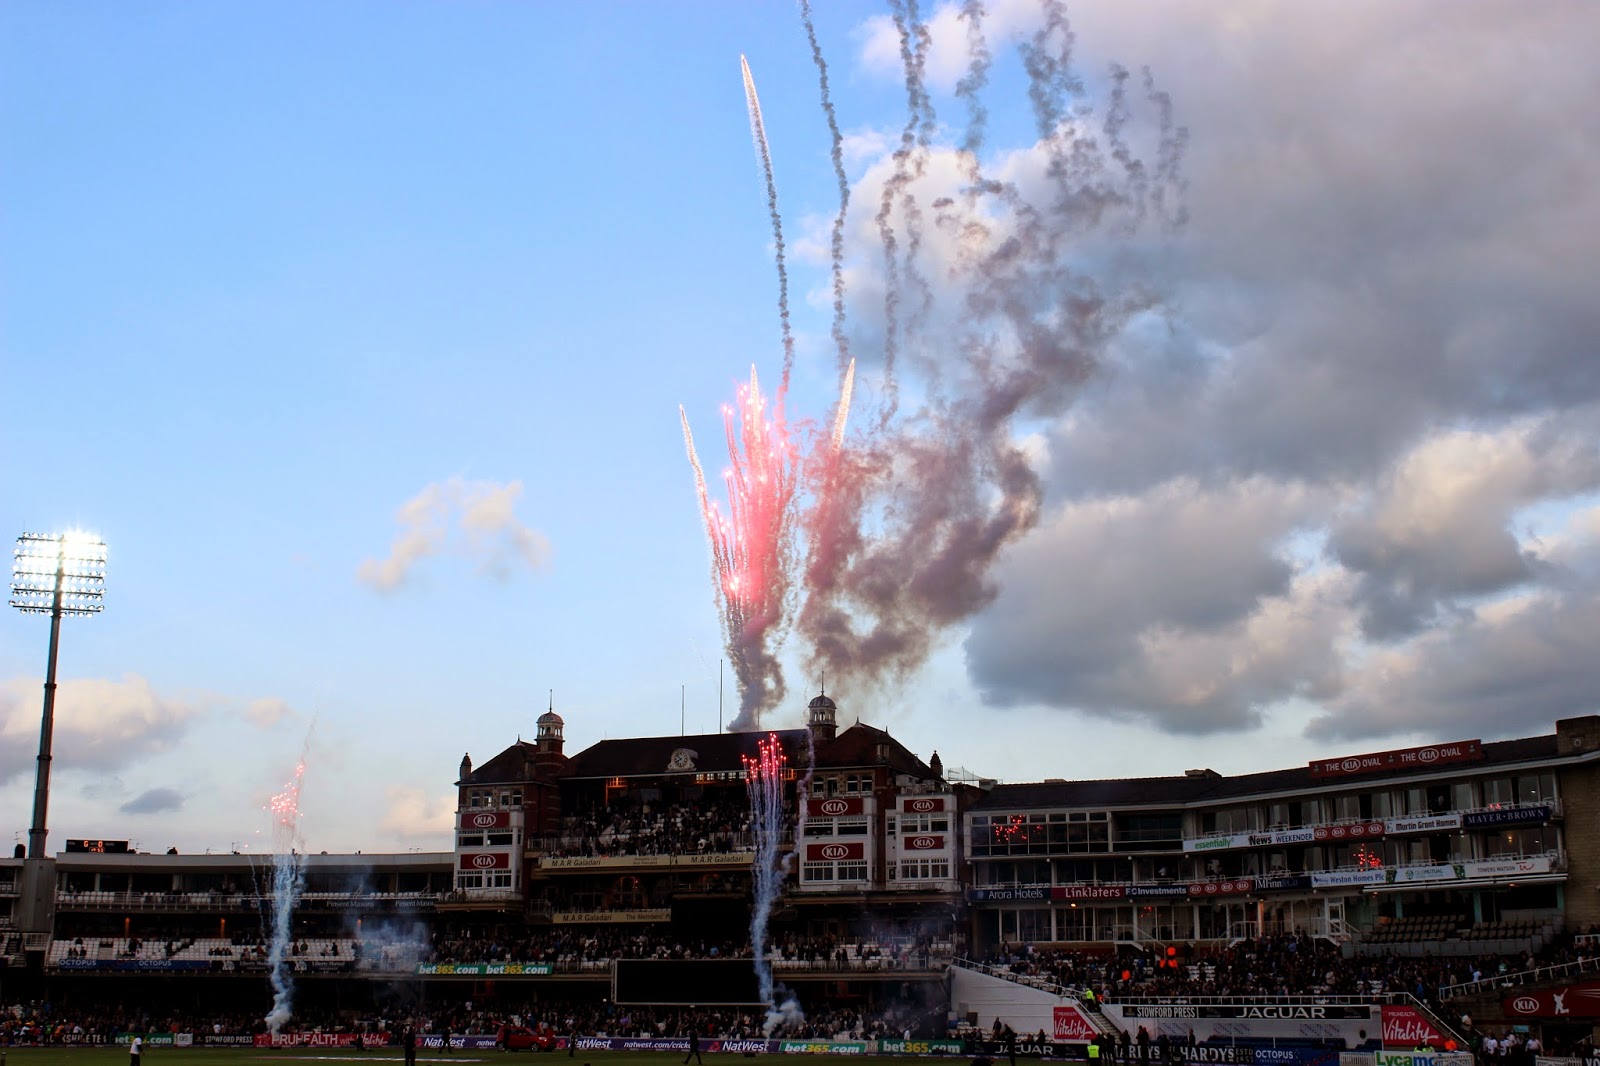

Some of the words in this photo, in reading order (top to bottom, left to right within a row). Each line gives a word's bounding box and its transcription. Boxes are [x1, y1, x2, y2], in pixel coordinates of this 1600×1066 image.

[1400, 753, 1416, 762] THE
[1440, 748, 1461, 757] OVAL
[1325, 763, 1339, 772] THE
[1362, 757, 1382, 767] OVAL
[476, 815, 494, 826] KIA
[1396, 822, 1417, 831] Martin
[1418, 821, 1435, 829] Grant
[1436, 819, 1457, 828] Homes
[1194, 838, 1231, 849] essentially
[1248, 835, 1272, 845] News
[1276, 833, 1313, 843] WEEKENDER
[476, 856, 493, 866] KIA
[715, 855, 743, 863] Galadari
[1330, 876, 1352, 884] Weston
[1353, 875, 1374, 883] Homes
[1375, 873, 1385, 881] Plc
[988, 890, 1012, 899] Arora
[1015, 889, 1043, 899] Hotels
[1065, 887, 1120, 898] Linklaters
[418, 965, 478, 974] bet365.com
[485, 964, 548, 974] bet365.com
[1516, 999, 1536, 1011] KIA
[1137, 1007, 1172, 1018] STOWFORD
[1173, 1007, 1195, 1018] PRESS
[1236, 1006, 1326, 1018] JAGUAR
[1054, 1016, 1093, 1039] Vitality
[1383, 1018, 1438, 1045] Vitality
[114, 1036, 172, 1044] et3.com
[205, 1035, 235, 1043] STOWFORD
[236, 1035, 253, 1043] PRESS
[356, 1033, 388, 1046] tality
[568, 1039, 612, 1048] atWest
[722, 1041, 769, 1051] NatWest
[784, 1043, 859, 1053] bet365.com
[883, 1041, 960, 1054] bet365.com
[1180, 1047, 1235, 1061] HARDYS
[1255, 1049, 1294, 1059] OCTOPUS
